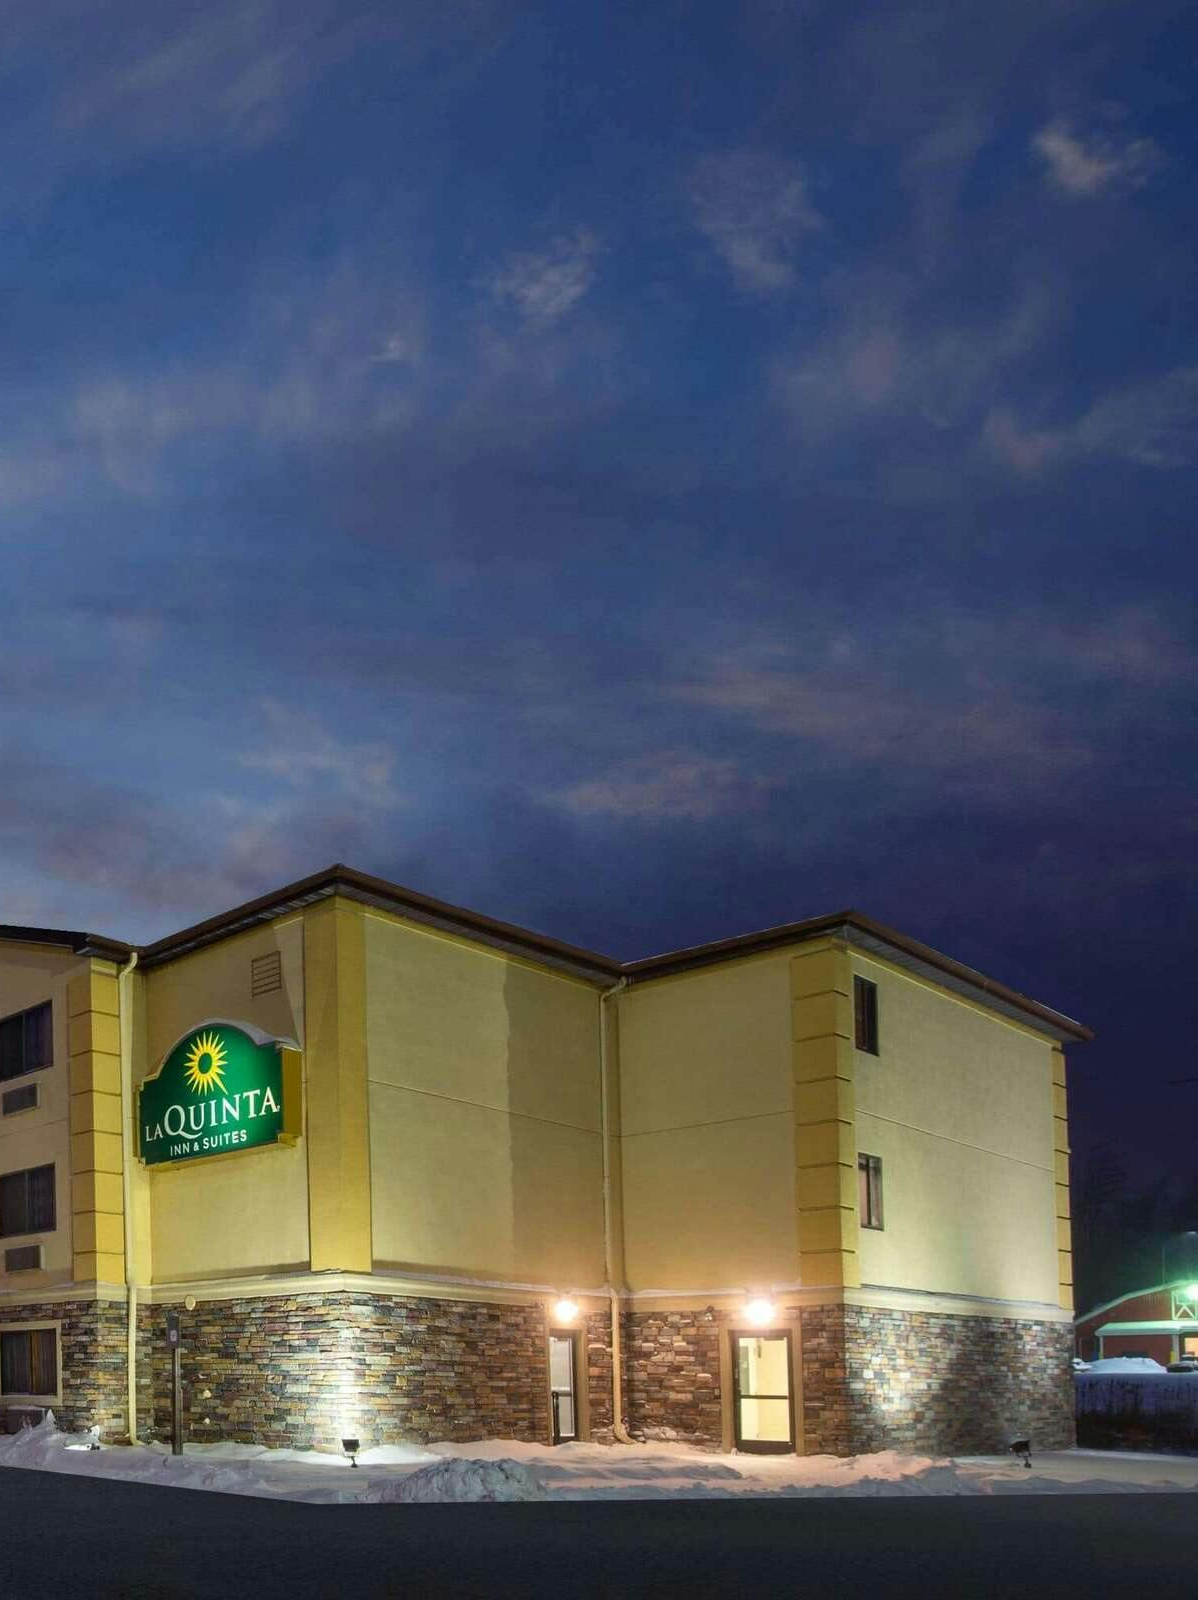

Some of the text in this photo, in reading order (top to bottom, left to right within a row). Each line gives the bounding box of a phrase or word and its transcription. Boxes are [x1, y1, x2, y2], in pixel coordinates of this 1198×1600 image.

[145, 1086, 278, 1141] LA QUINTA
[170, 1129, 247, 1157] INN & SUITES
